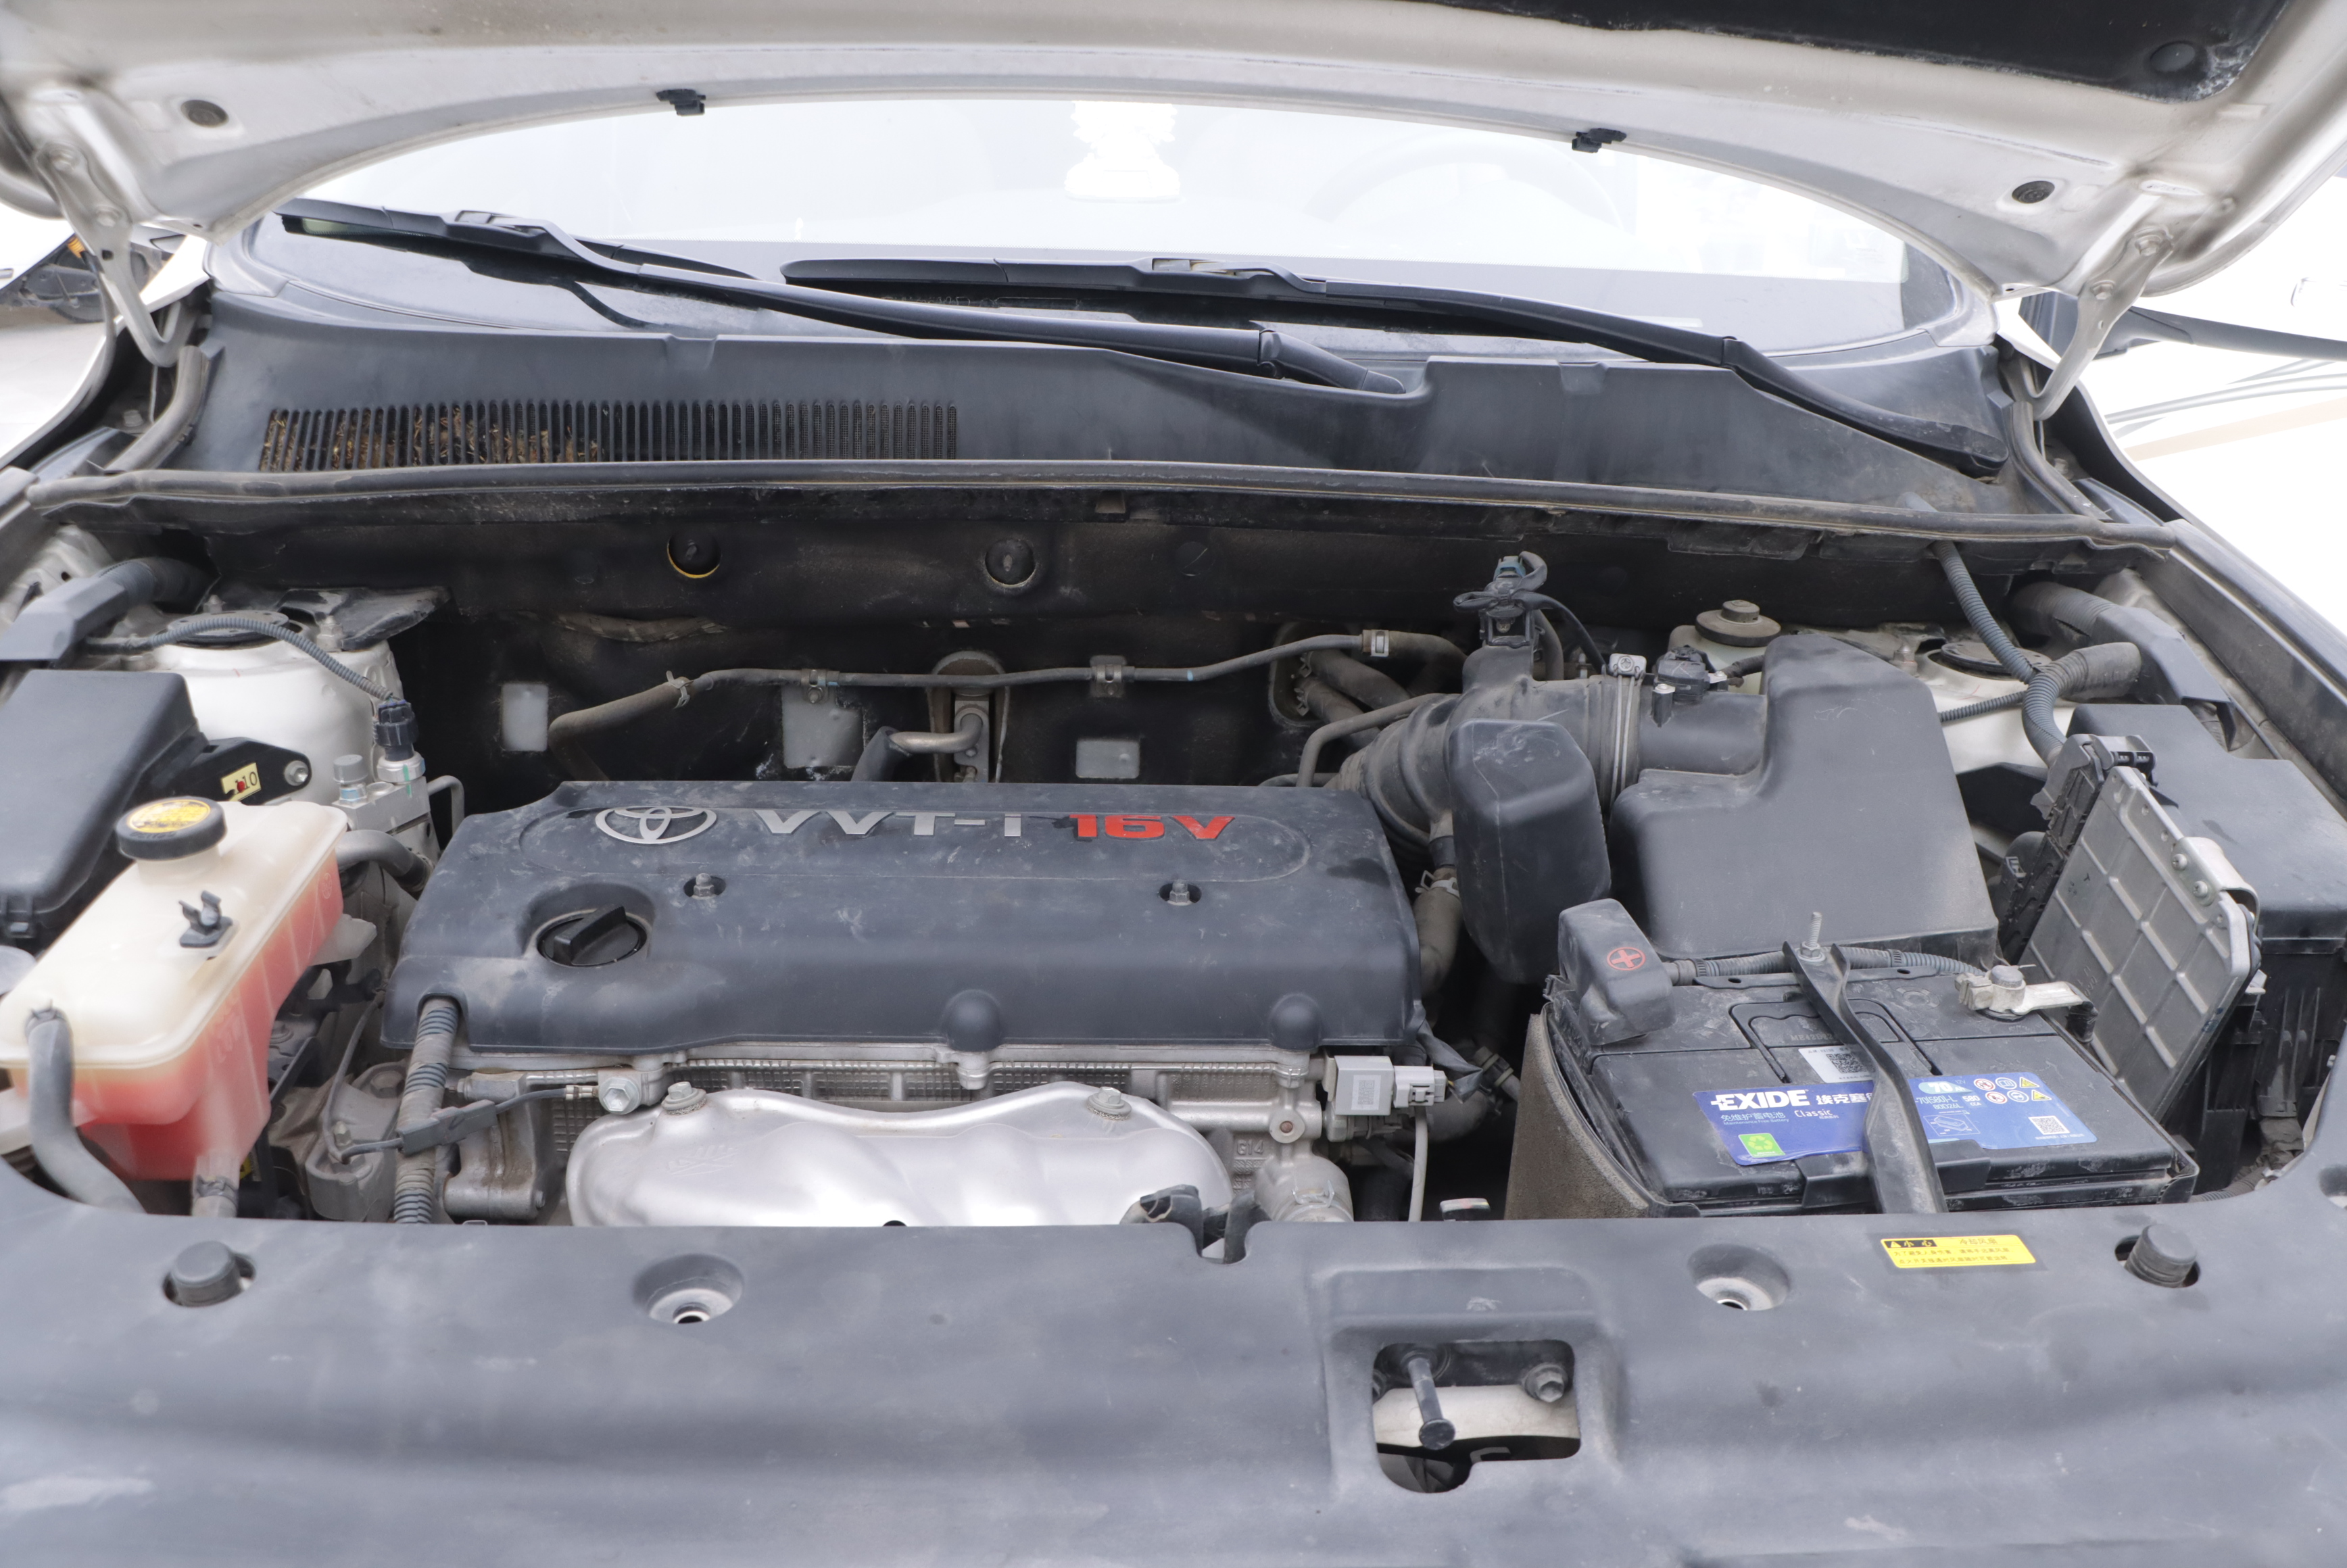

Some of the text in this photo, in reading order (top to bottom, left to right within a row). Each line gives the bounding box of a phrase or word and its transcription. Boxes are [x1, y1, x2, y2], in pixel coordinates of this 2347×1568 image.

[1070, 814, 1234, 840] 16V
[1928, 1082, 1953, 1093] 70
[1711, 1090, 1810, 1110] EXIDE
[1721, 1112, 1786, 1122] 免维护蓄电池
[1794, 1108, 1833, 1118] Classic
[1237, 1140, 1264, 1155] G14
